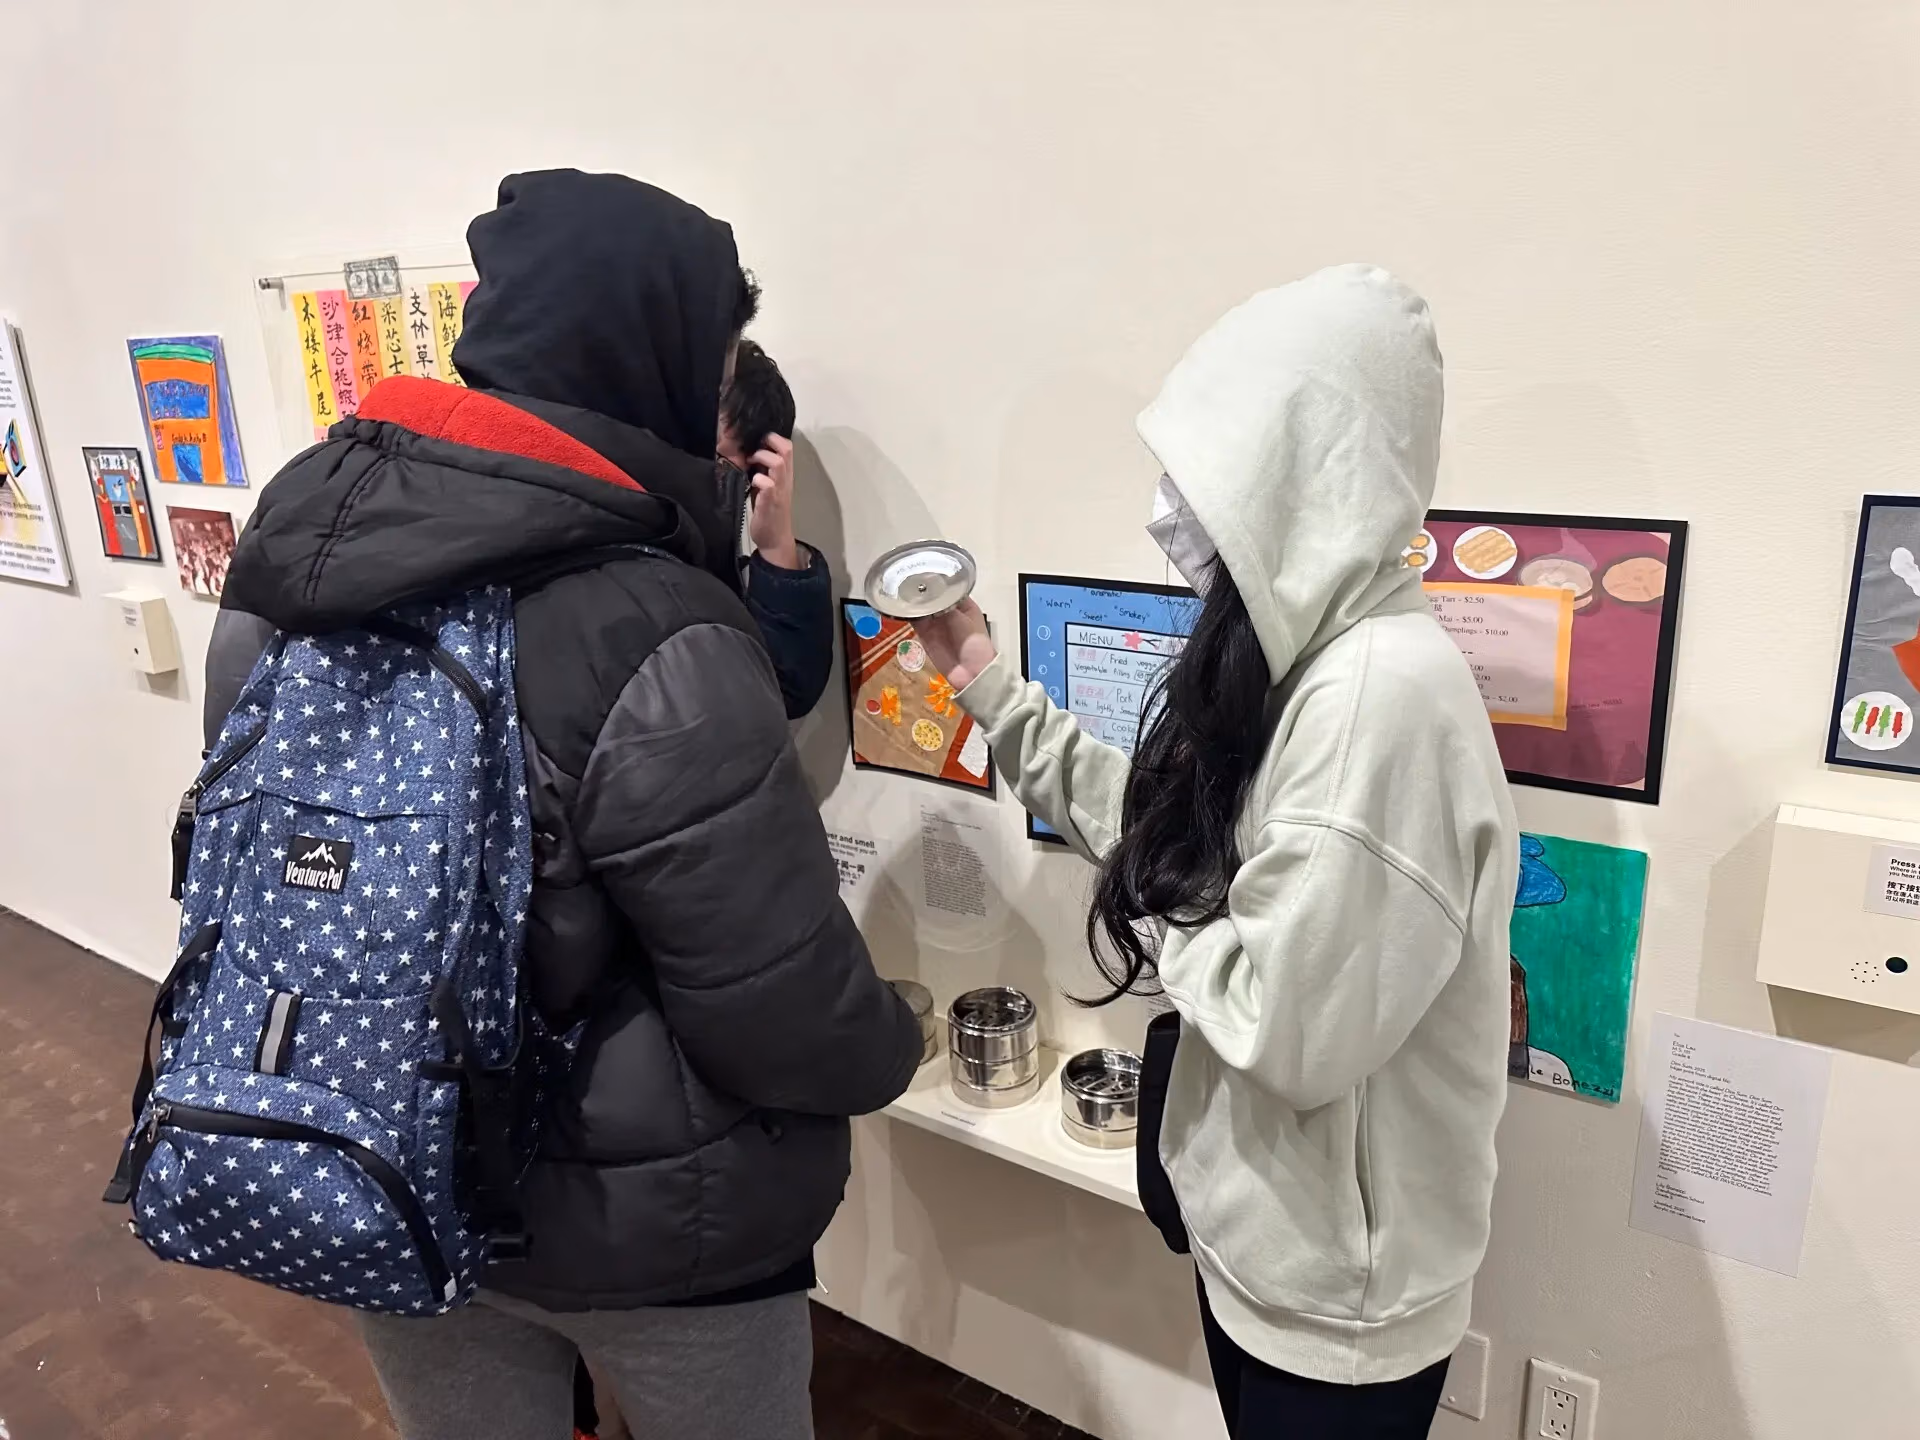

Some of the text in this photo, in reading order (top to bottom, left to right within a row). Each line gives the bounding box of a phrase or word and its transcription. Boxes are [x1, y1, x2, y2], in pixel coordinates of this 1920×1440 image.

[1464, 596, 1484, 604] $2.50
[1462, 616, 1483, 624] $5.00
[1485, 628, 1509, 637] $10.00
[1079, 631, 1114, 646] MENU
[839, 835, 853, 844] and
[854, 839, 875, 849] smell
[1891, 859, 1916, 868] Press
[285, 861, 344, 890] VenturePal
[1552, 1072, 1615, 1097] Bonezzi
